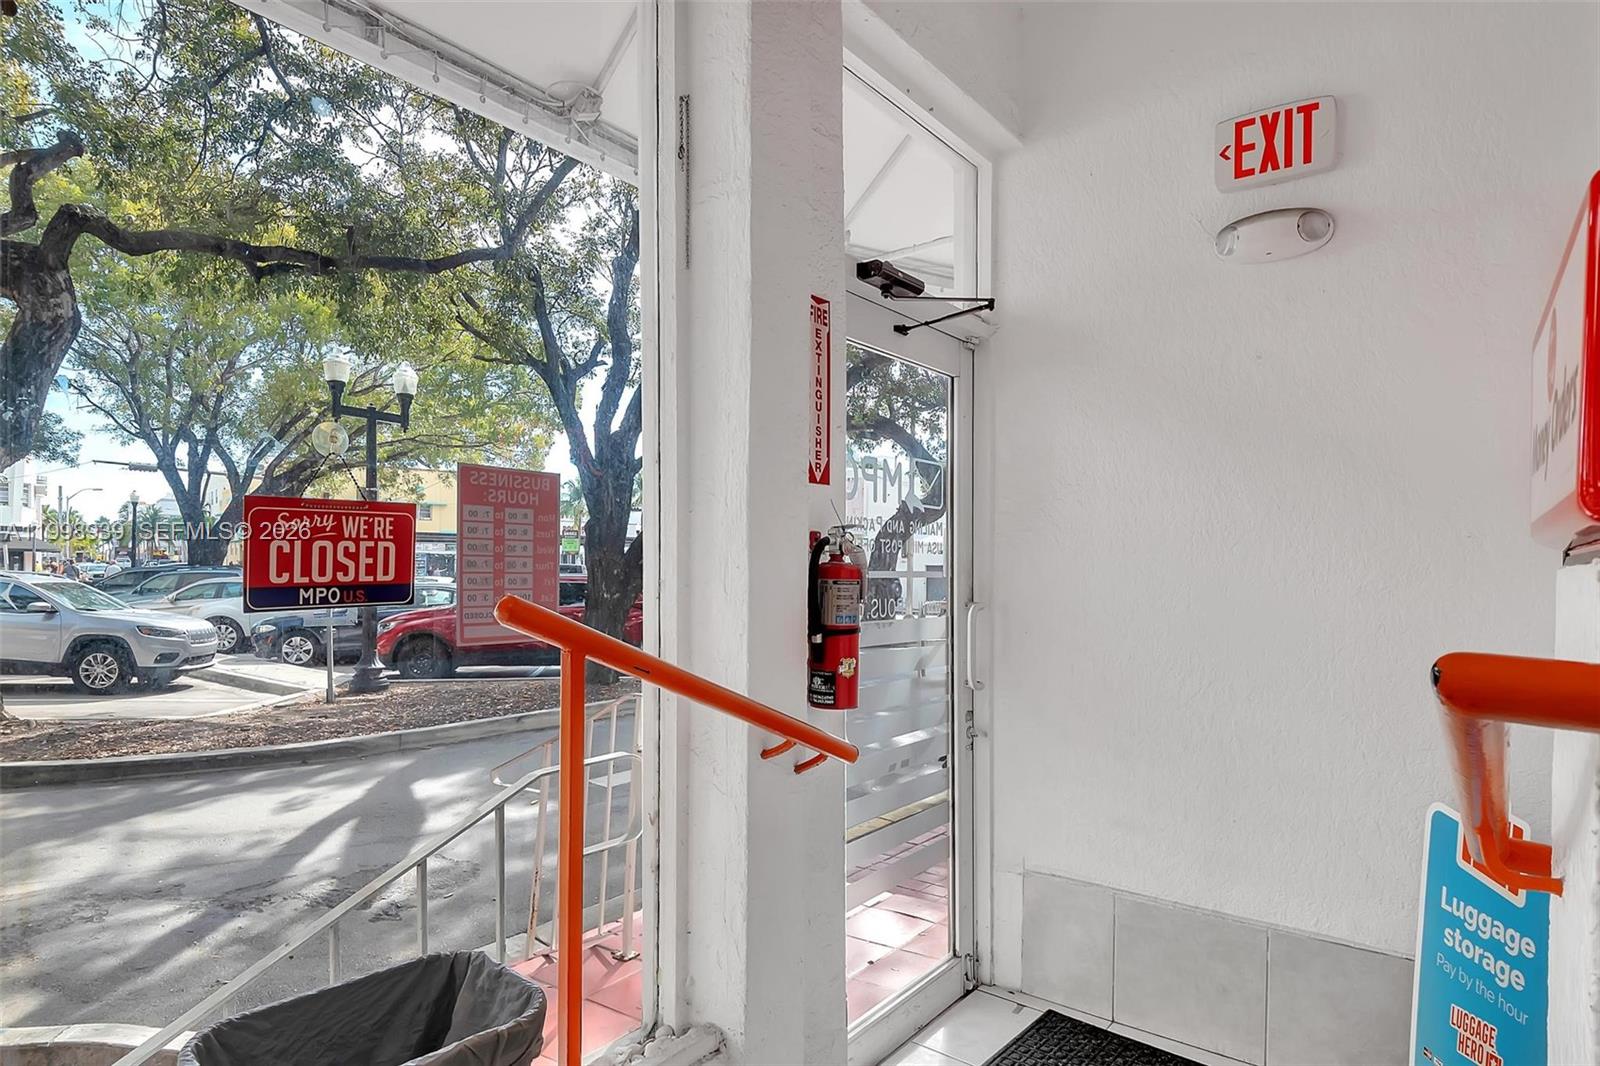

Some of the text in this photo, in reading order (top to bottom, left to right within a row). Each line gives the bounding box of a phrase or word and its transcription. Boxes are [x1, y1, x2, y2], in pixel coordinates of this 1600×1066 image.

[1233, 102, 1320, 180] EXIT
[814, 327, 823, 473] EXTINGUISHER
[277, 512, 394, 539] Sorry WE'RE
[269, 540, 396, 584] CLOSED
[299, 587, 341, 605] MPO
[1440, 885, 1537, 959] Luggage
[1443, 927, 1526, 992] storage
[1436, 953, 1529, 1025] Pay by the hour
[1451, 1005, 1496, 1049] LUGGAGE
[1458, 1033, 1484, 1065] HERO
